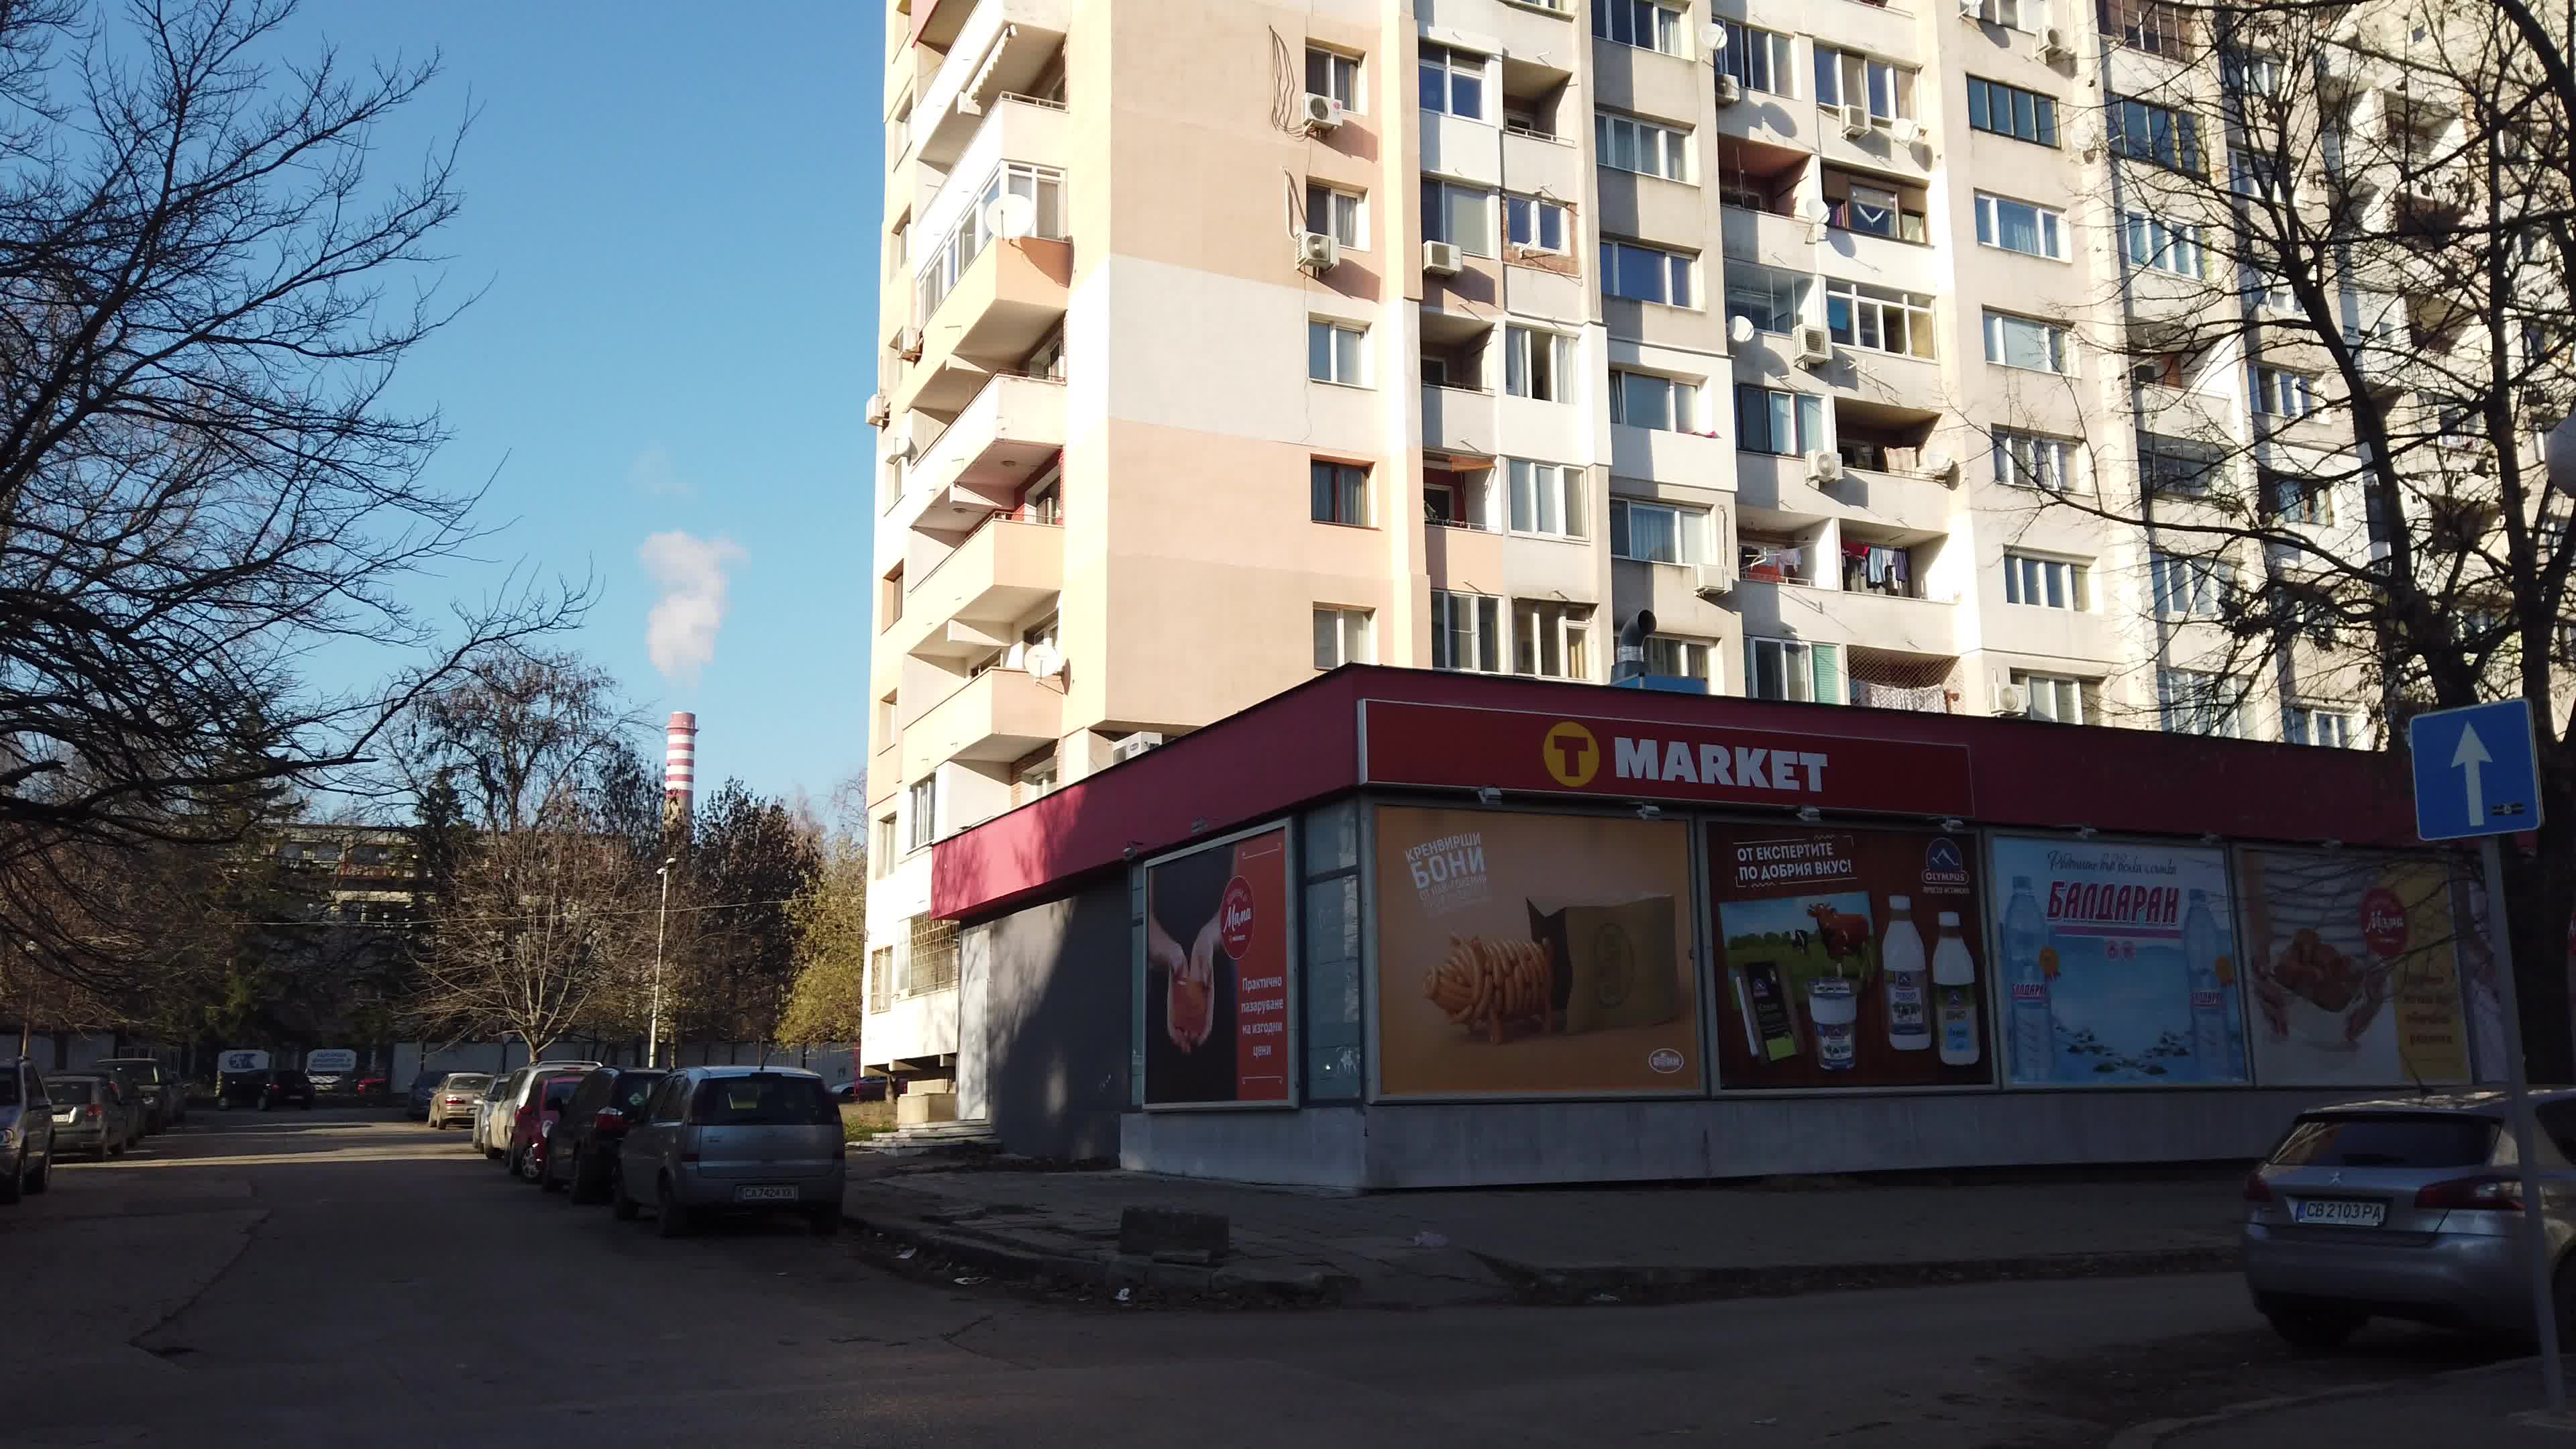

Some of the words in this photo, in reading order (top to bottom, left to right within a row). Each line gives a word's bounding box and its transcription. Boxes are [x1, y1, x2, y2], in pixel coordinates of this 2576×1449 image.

[1614, 737, 1829, 793] MARKET
[1405, 832, 1482, 861] КРЕНВИРШИ
[1737, 847, 1754, 861] ОТ
[1756, 843, 1834, 861] ЕКСПЕРТИТЕ
[1409, 847, 1485, 889] БОНИ
[1738, 866, 1758, 881] ПО
[1761, 862, 1812, 880] ДОБРИЯ
[1814, 859, 1852, 875] ВКУС!
[1925, 872, 1965, 881] OLYMPUS
[2047, 881, 2180, 924] БАЛДАРАН
[1223, 904, 1251, 933] Мама
[1242, 976, 1283, 993] Практично
[1241, 998, 1283, 1014] пазаруване
[1242, 1024, 1251, 1034] на
[1252, 1022, 1283, 1035] изгодни
[1253, 1045, 1271, 1058] цени
[2307, 1203, 2323, 1217] CB
[2326, 1203, 2359, 1219] 2103
[2362, 1205, 2381, 1219] PA
